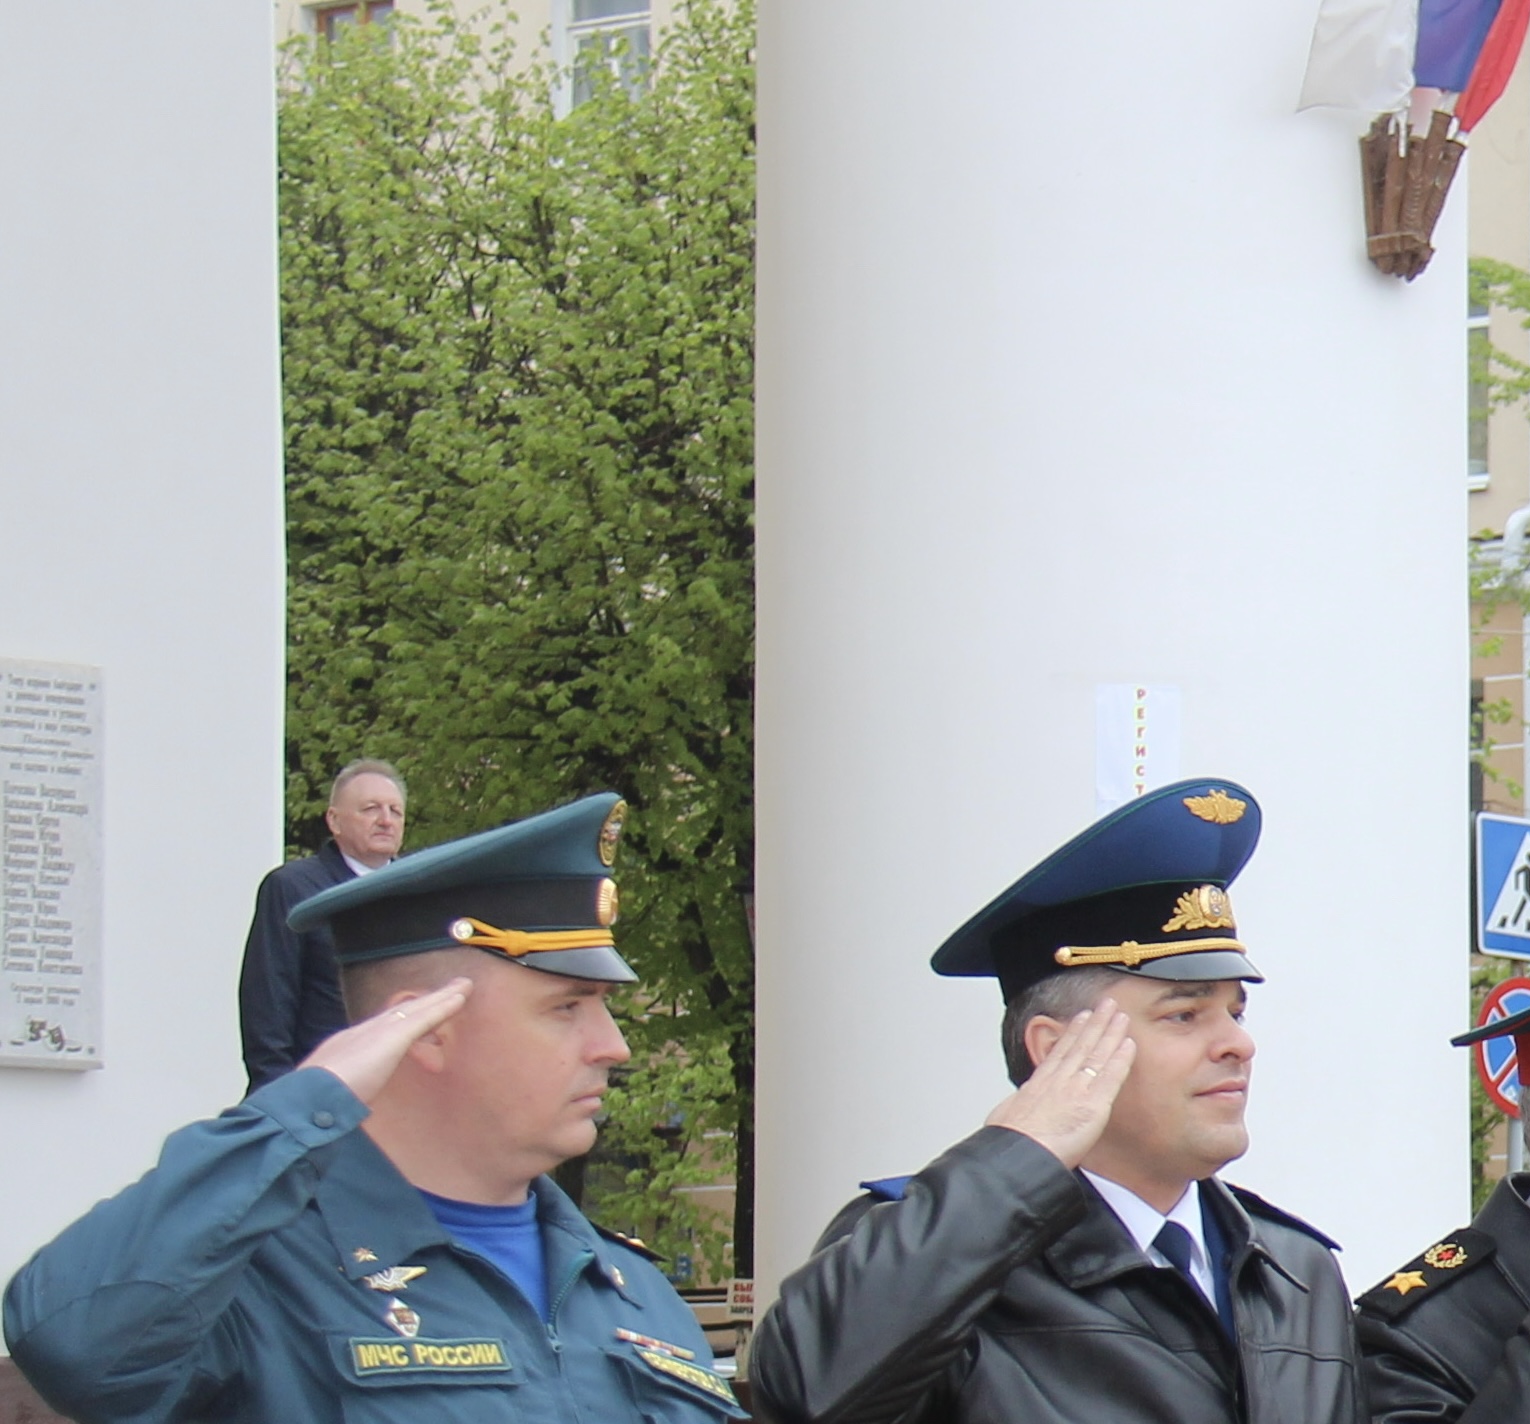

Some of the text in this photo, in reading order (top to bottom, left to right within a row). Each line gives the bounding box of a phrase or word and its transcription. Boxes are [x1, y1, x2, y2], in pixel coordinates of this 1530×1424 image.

[1134, 688, 1147, 795] РЕГИСТ
[357, 1343, 503, 1368] МЧС РОССИИ
